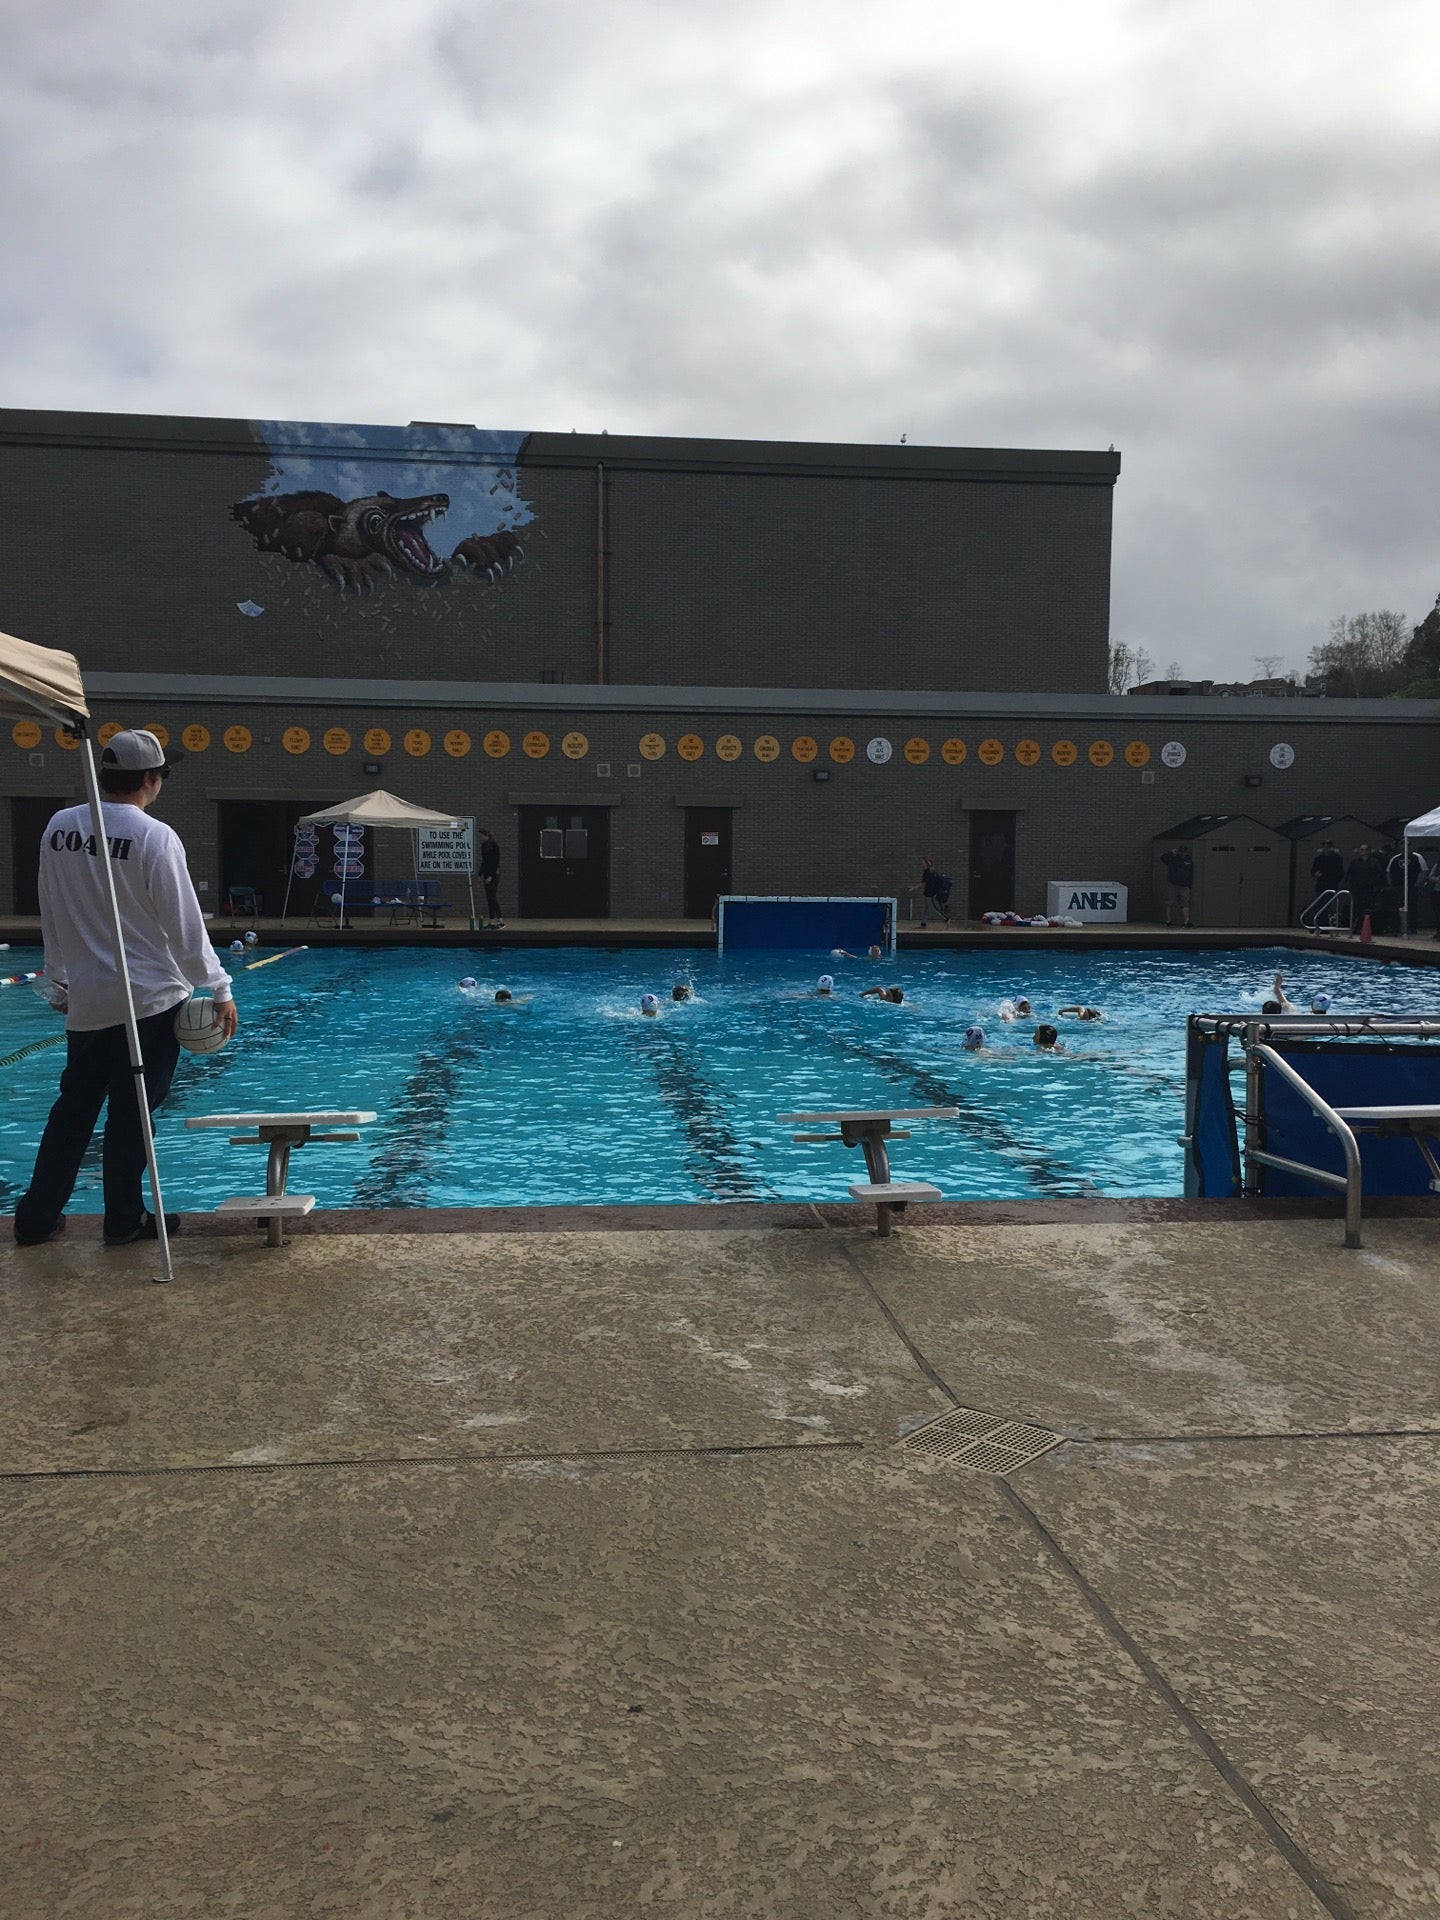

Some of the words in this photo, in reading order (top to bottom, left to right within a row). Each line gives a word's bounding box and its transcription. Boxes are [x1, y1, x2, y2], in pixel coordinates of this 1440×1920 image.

[429, 831, 437, 839] TO
[439, 831, 450, 839] USE
[452, 831, 463, 839] THE
[51, 829, 132, 860] COAH
[421, 841, 454, 849] SWIMMING
[422, 851, 437, 859] WHILE
[438, 851, 451, 859] POOL
[420, 861, 431, 869] ARE
[432, 861, 441, 869] ON
[442, 861, 452, 869] THE
[1067, 891, 1118, 910] ANHS
